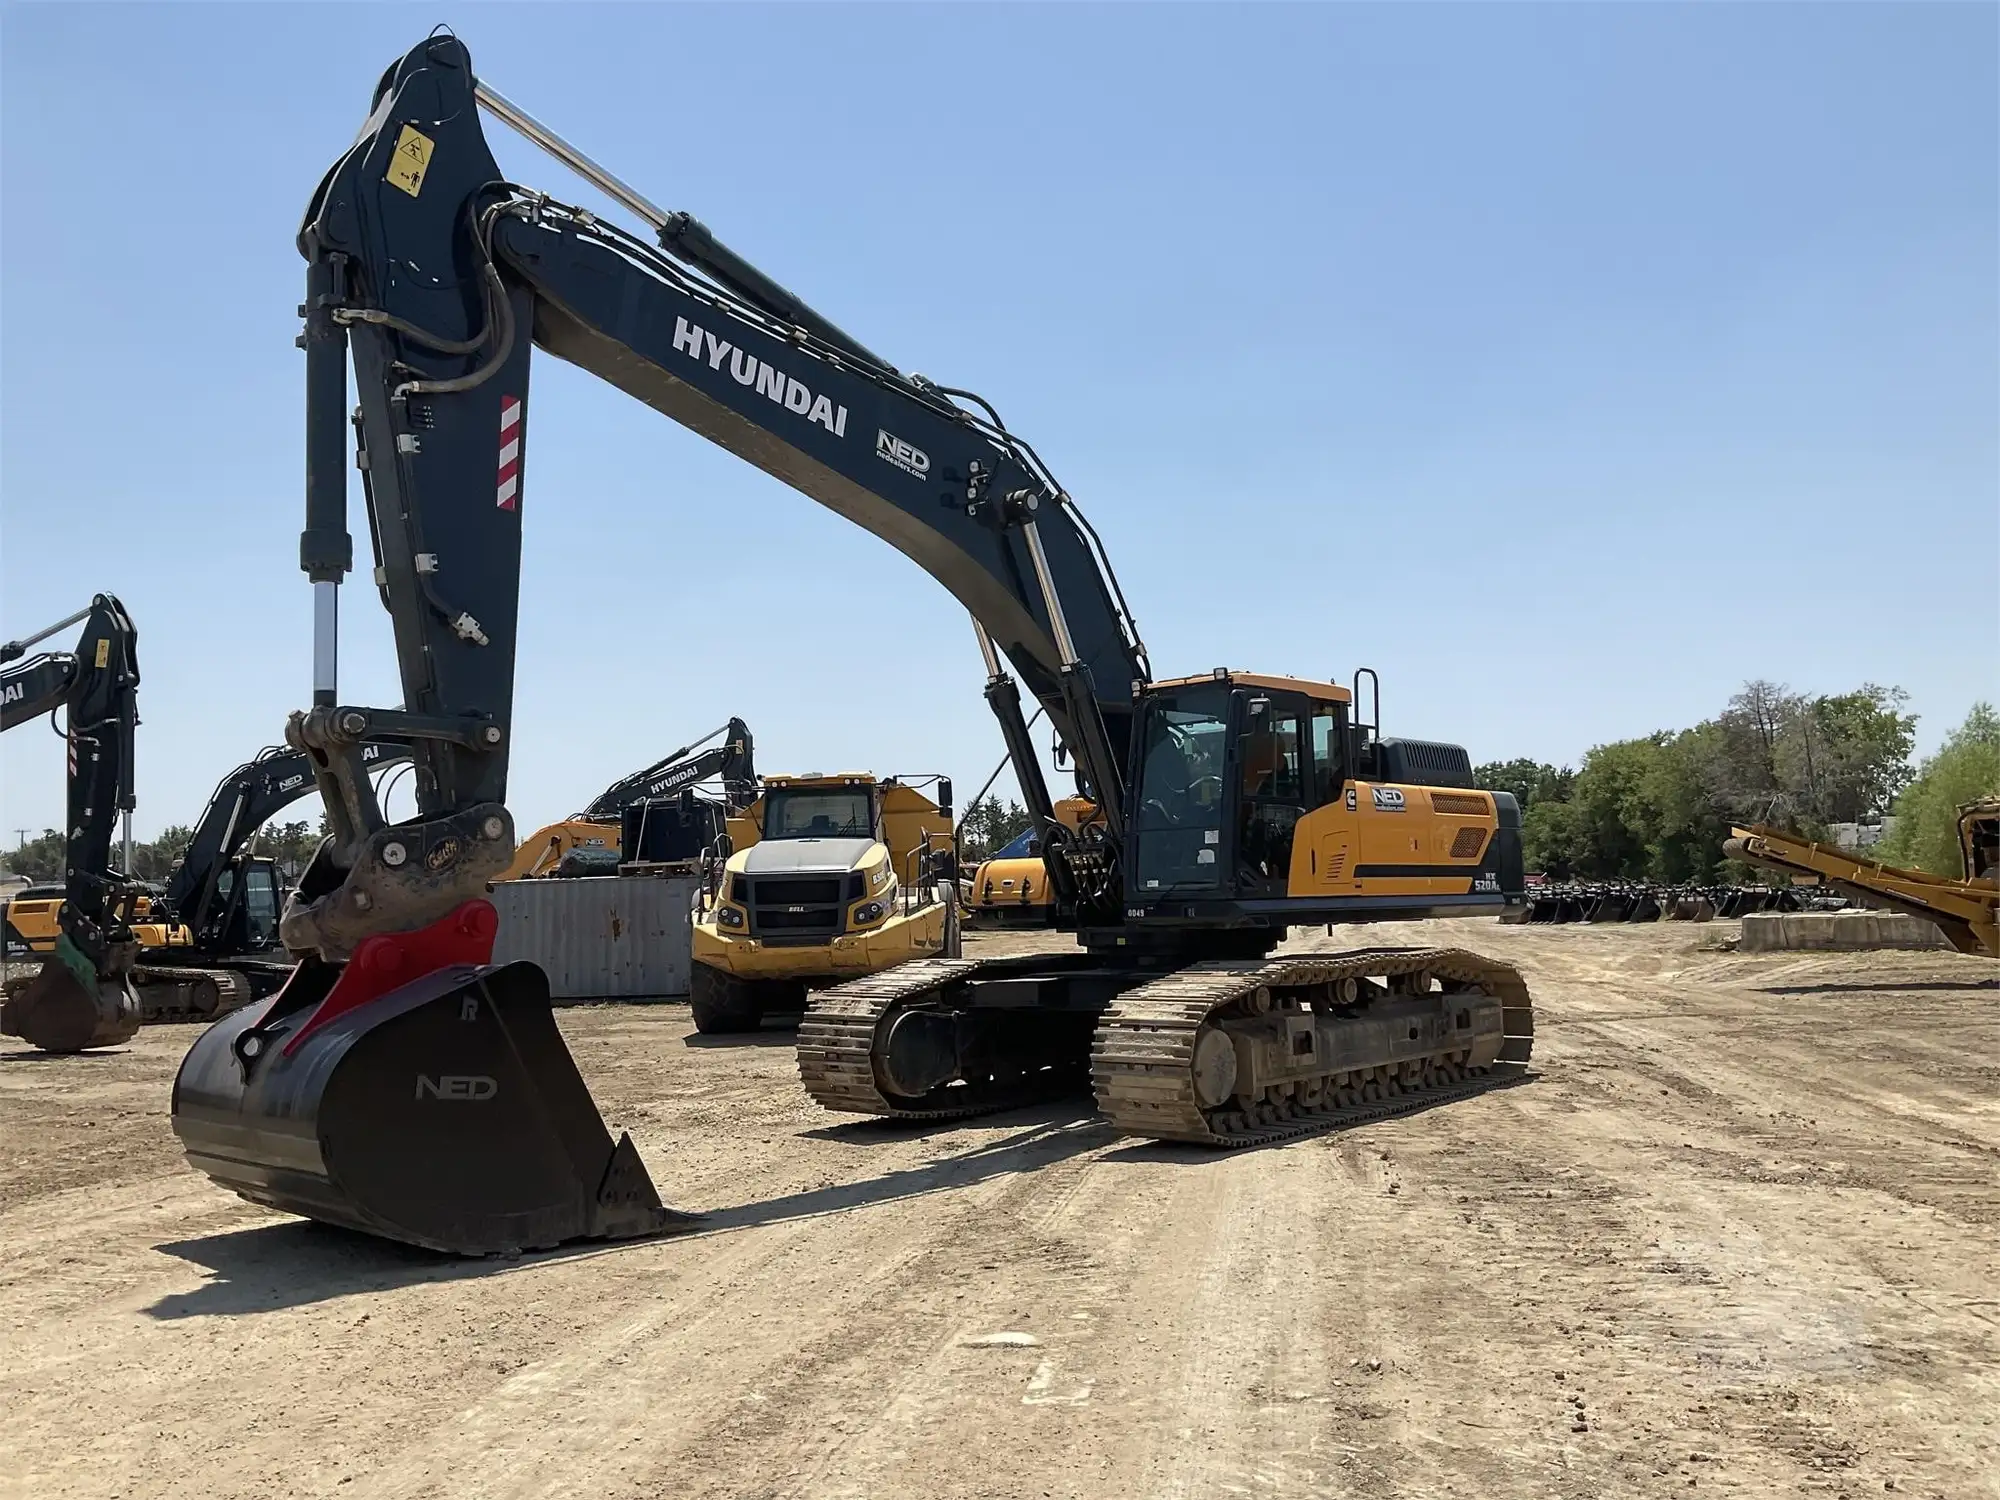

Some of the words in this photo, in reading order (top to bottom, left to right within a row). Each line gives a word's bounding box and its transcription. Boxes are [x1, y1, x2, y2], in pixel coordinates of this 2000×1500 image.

[672, 315, 848, 438] HYUNDAI
[876, 428, 931, 473] NED
[876, 450, 927, 482] nedealers.com
[279, 774, 303, 790] NED
[650, 765, 699, 794] HYUNDAI
[1372, 788, 1405, 805] NED
[415, 1073, 498, 1101] NED
